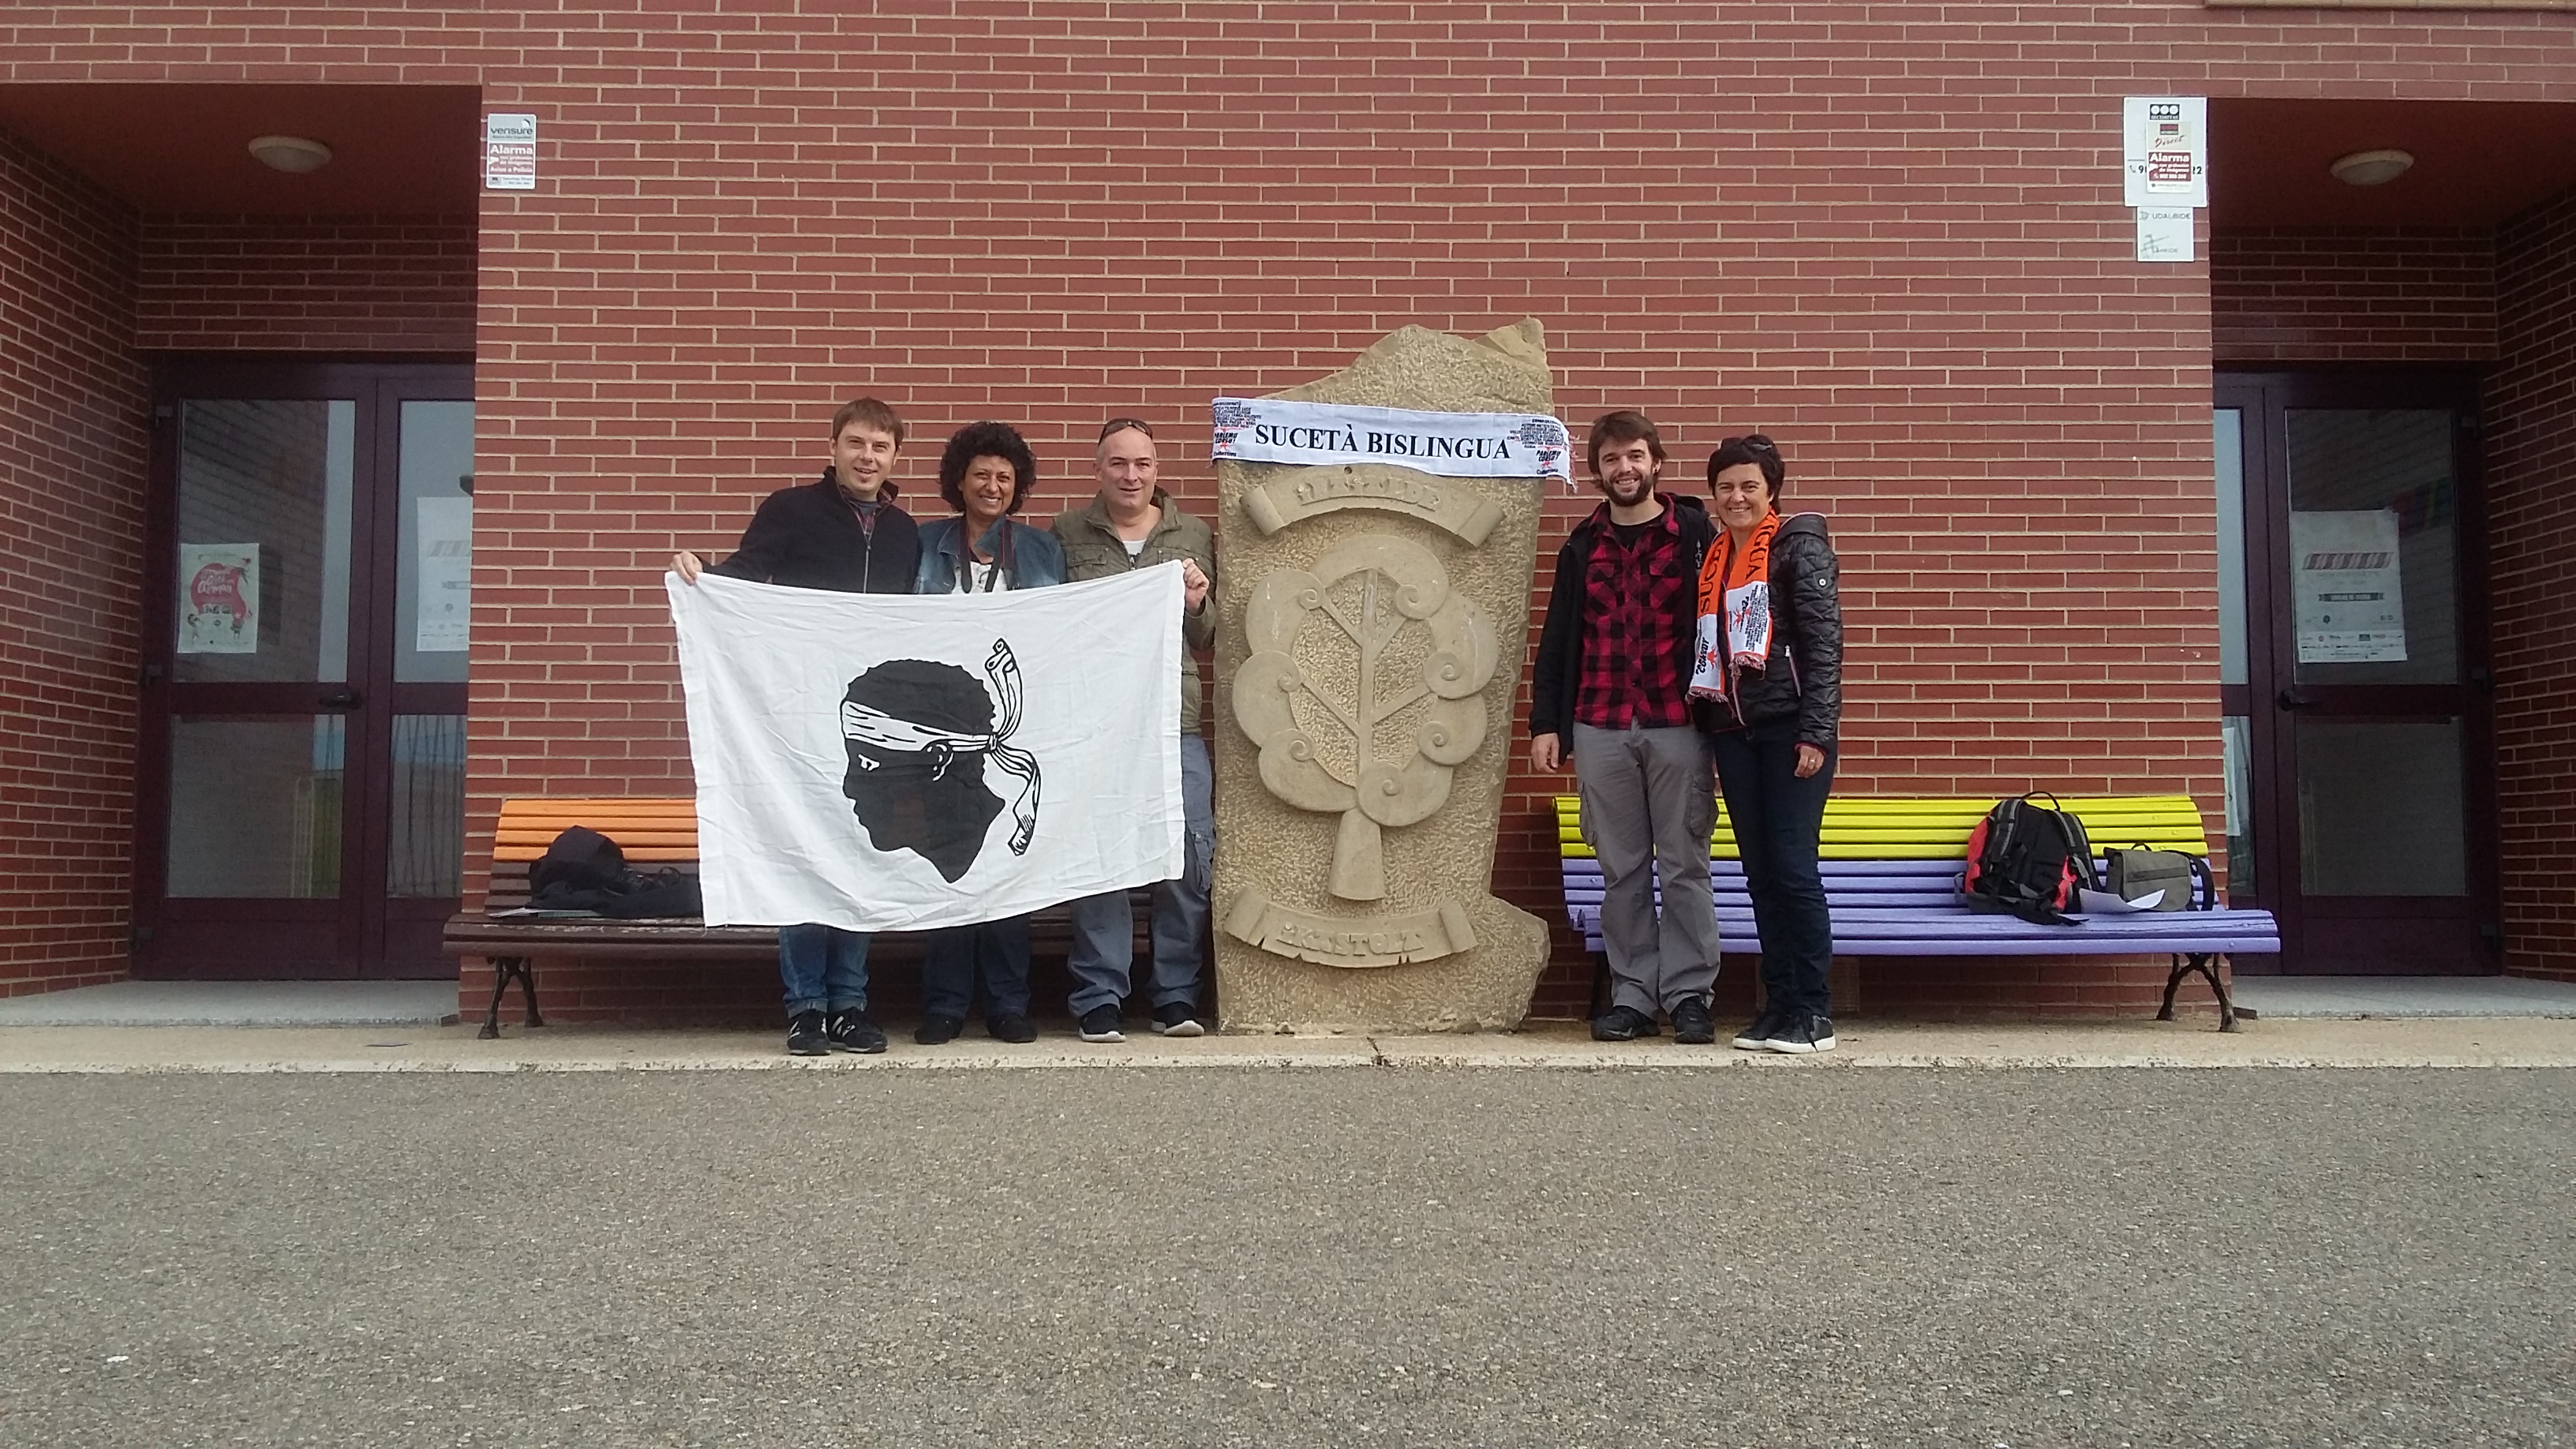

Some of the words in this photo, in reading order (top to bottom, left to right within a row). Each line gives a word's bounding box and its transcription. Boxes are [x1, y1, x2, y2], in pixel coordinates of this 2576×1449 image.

[490, 144, 533, 155] Alarma
[2149, 153, 2189, 163] Alarma
[1255, 424, 1358, 452] SUCETÀ
[1367, 432, 1511, 459] BISLINGUA
